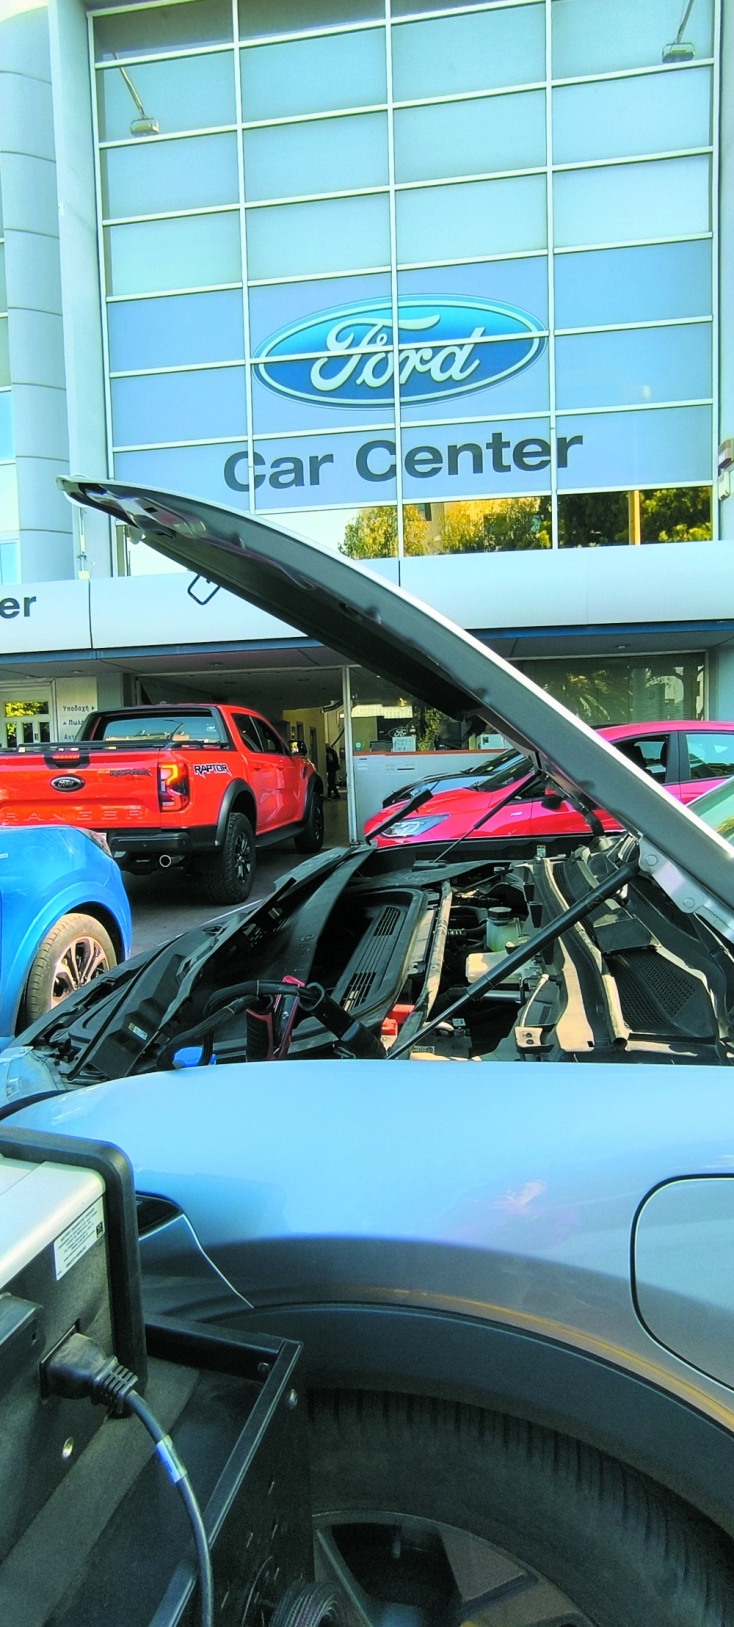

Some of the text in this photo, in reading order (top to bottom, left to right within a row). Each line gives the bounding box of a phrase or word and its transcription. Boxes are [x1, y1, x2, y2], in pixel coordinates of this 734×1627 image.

[310, 313, 486, 392] Ford
[223, 431, 584, 492] Car Center
[193, 763, 232, 778] RAPTOR
